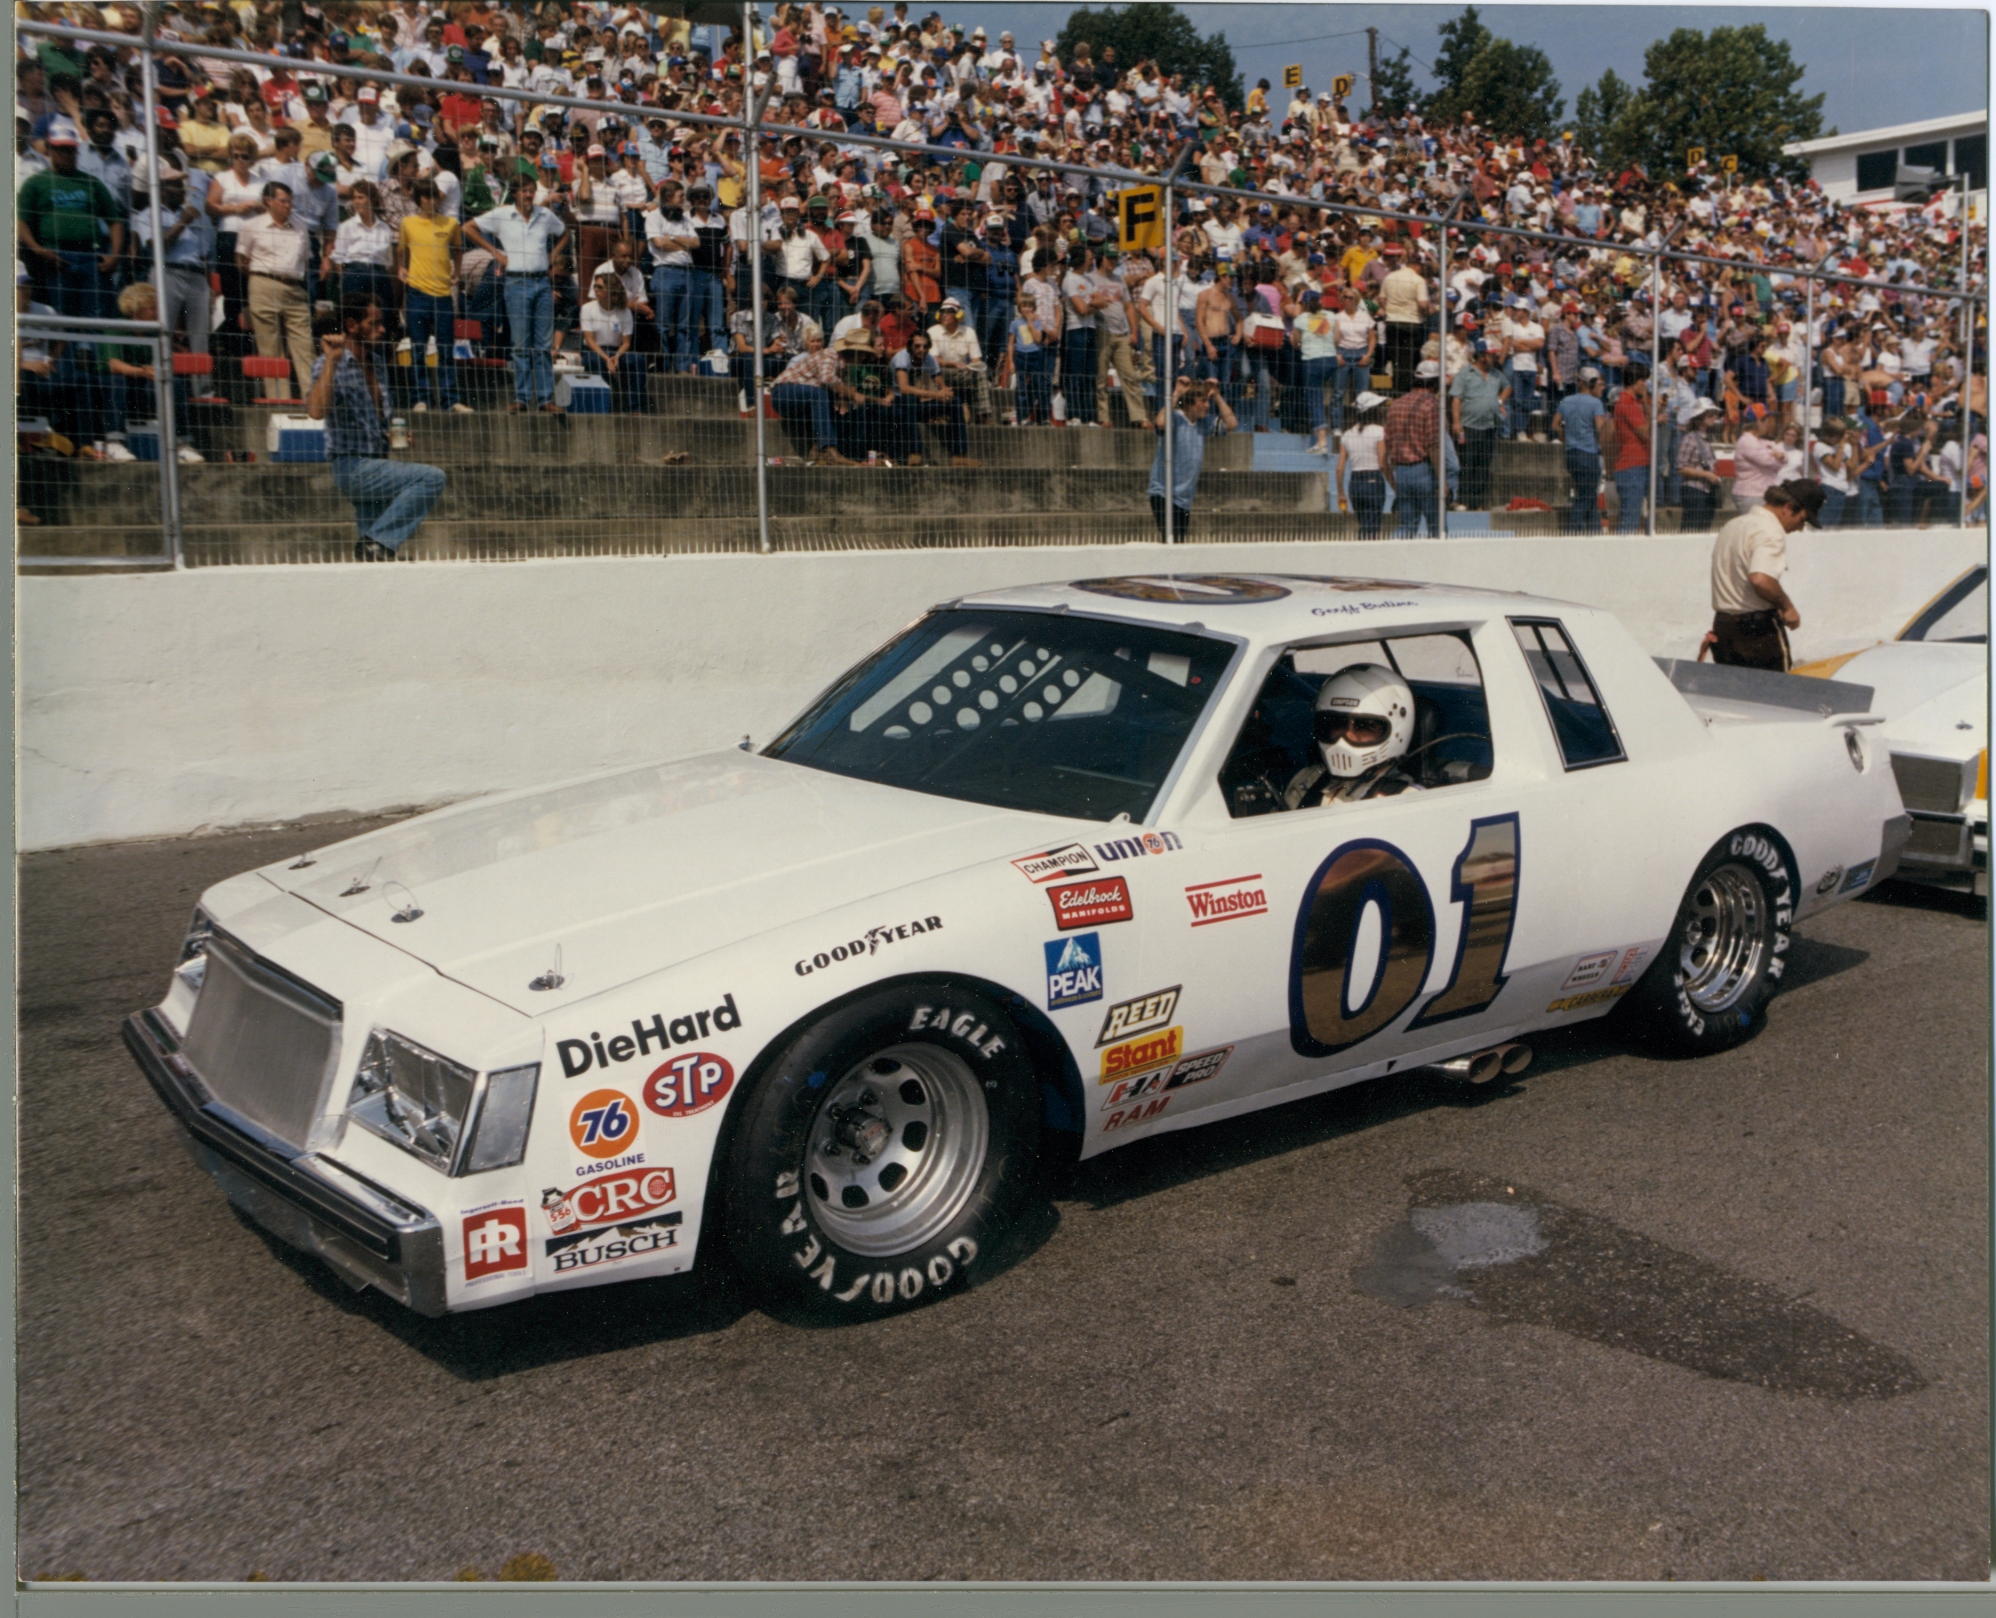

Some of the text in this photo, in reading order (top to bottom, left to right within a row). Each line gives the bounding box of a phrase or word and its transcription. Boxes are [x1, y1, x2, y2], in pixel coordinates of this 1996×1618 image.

[1285, 66, 1299, 85] E
[1335, 78, 1349, 94] D
[1125, 192, 1156, 242] F
[1022, 851, 1089, 875] CHAMPION
[1059, 886, 1123, 910] Edelbrock
[1061, 904, 1126, 920] MANIFOLDS
[1185, 888, 1267, 919] Winston
[1288, 811, 1522, 1058] 01
[1049, 965, 1101, 999] PEAK
[908, 1007, 1007, 1059] EAGLE
[1101, 990, 1177, 1042] REED
[555, 992, 742, 1079] DieHard
[1105, 1029, 1177, 1076] Stant
[654, 1054, 724, 1109] STP
[1174, 1052, 1224, 1077] SPEED
[1182, 1065, 1216, 1084] PRO
[577, 1097, 631, 1147] 76
[1102, 1096, 1172, 1132] RAM
[575, 1152, 645, 1176] GASOLINE
[571, 1168, 674, 1222] CRC
[549, 1206, 571, 1223] 5-56
[552, 1228, 678, 1273] BUSCH
